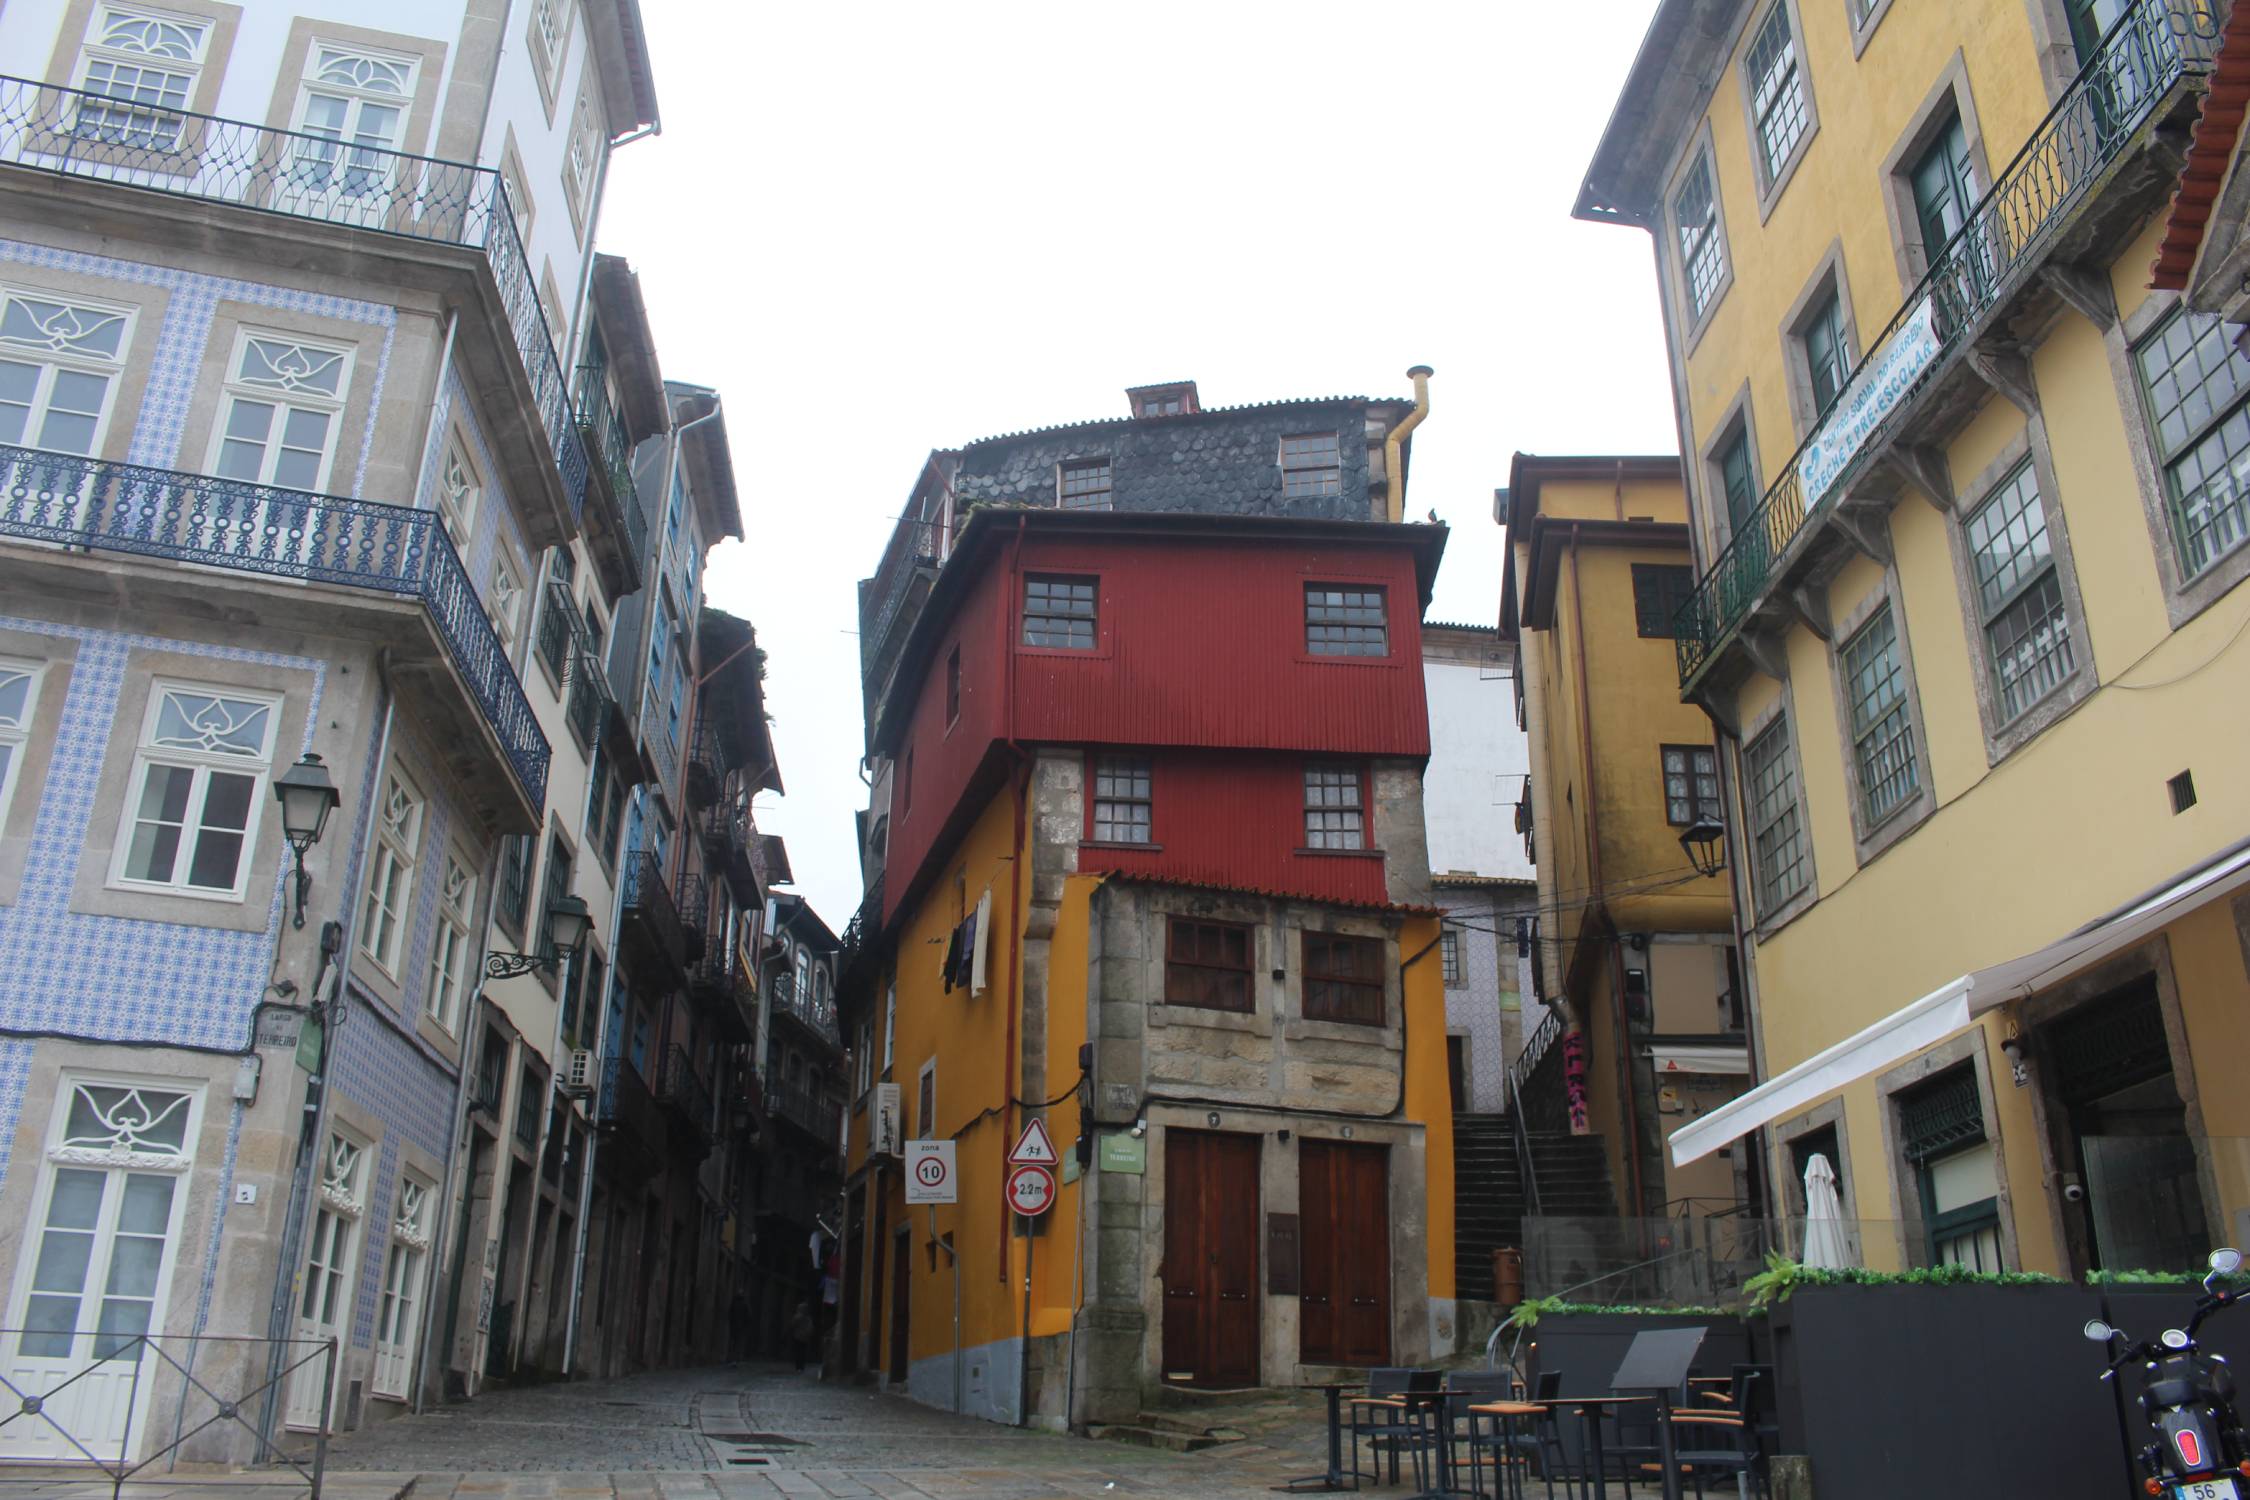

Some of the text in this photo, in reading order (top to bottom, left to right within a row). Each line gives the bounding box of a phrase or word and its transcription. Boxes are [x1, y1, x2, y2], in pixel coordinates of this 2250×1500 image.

[1824, 413, 1849, 452] CENTRO
[1850, 379, 1877, 418] SOCIAL
[1877, 363, 1889, 382] DO
[1808, 446, 1847, 501] CRECHE
[1846, 433, 1855, 453] E
[922, 1166, 940, 1179] 10
[2192, 1483, 2216, 1500] 56
